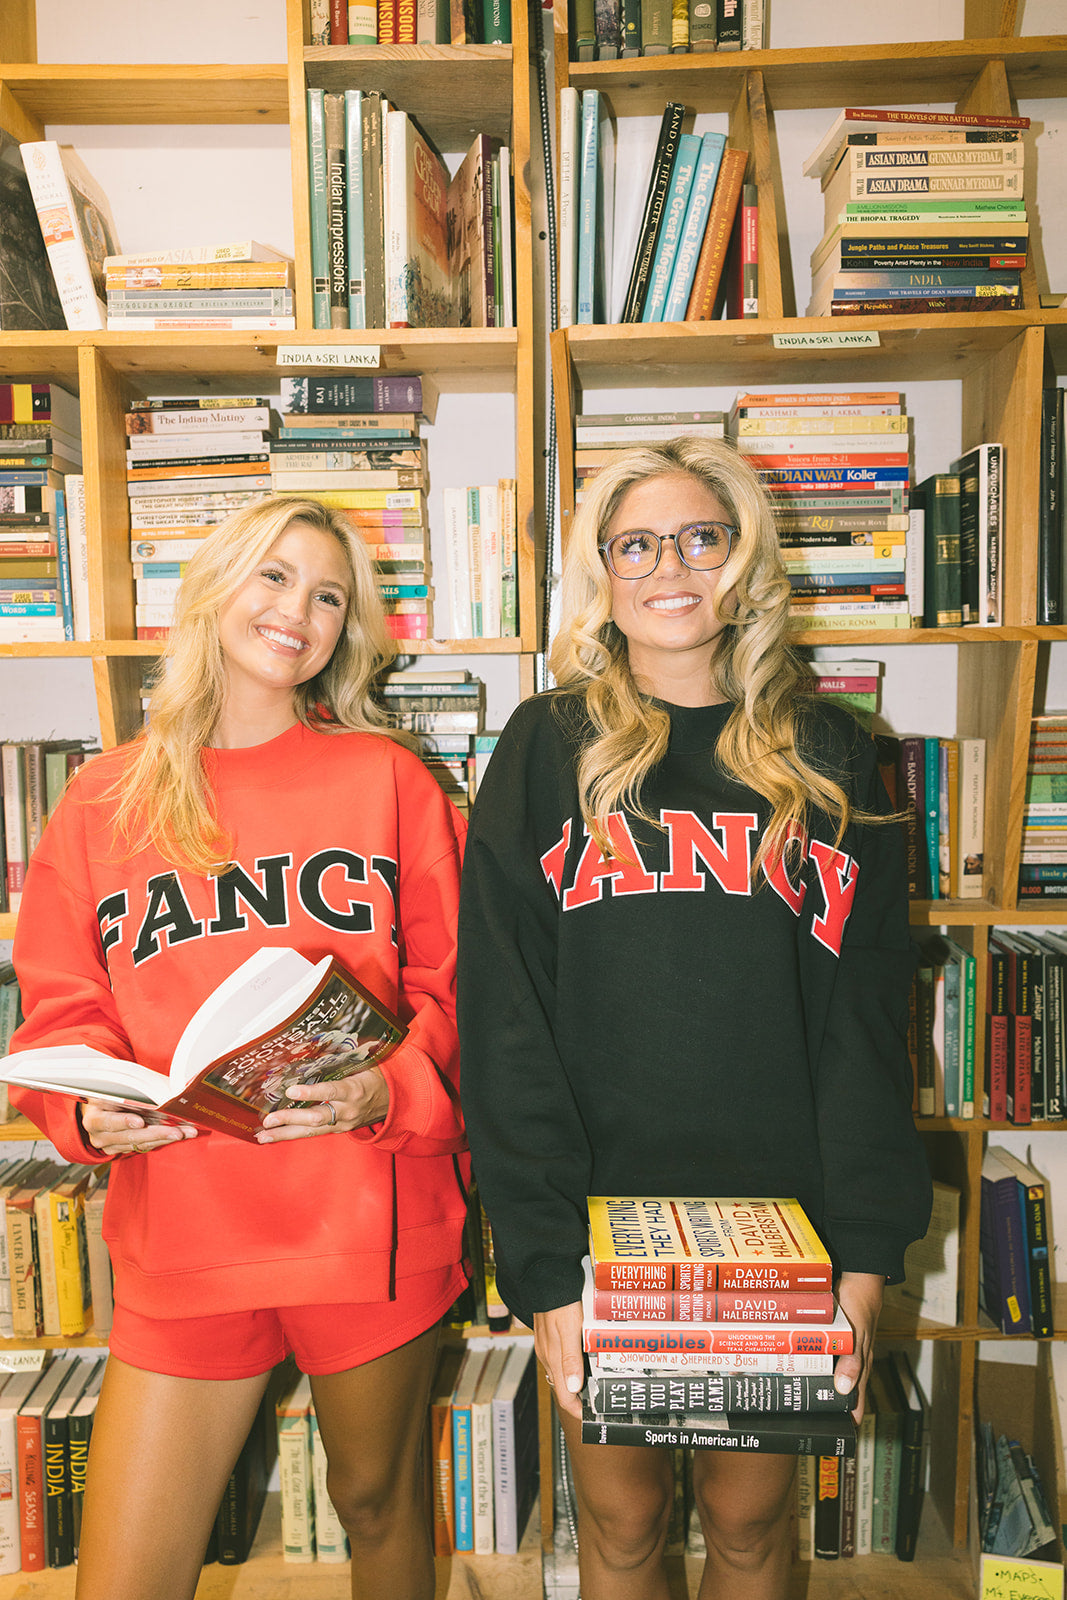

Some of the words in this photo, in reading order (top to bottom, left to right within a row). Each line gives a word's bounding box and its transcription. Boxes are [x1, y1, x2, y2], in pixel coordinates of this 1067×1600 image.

[669, 106, 682, 140] LAND
[900, 113, 925, 121] TRAVELS
[665, 143, 674, 159] OF
[868, 152, 896, 166] ASIAN
[896, 151, 928, 165] DRAMA
[929, 151, 964, 165] GUNNAR
[965, 150, 1000, 164] MYRDAL
[330, 162, 346, 206] Indian
[659, 164, 670, 186] THE
[675, 164, 692, 194] The
[869, 179, 896, 193] ASIAN
[897, 178, 929, 191] DRAMA
[930, 178, 965, 191] GUNNAR
[966, 176, 1001, 190] MYRDAL
[651, 188, 665, 224] TIGER
[666, 200, 684, 242] Great
[714, 218, 727, 258] INDIAN
[848, 244, 867, 252] Jungle
[330, 209, 348, 293] impressions
[652, 244, 675, 308] Moghuls
[701, 265, 717, 311] SUMMER
[909, 274, 942, 286] INDIA
[779, 337, 808, 345] INDIA
[282, 354, 312, 363] INDIA
[344, 355, 378, 364] LANKA
[316, 387, 325, 404] RAJ
[158, 414, 176, 425] The
[178, 414, 208, 424] Indian
[211, 412, 245, 423] Mutiny
[815, 470, 844, 481] WAY
[847, 469, 877, 480] Koller
[990, 456, 998, 526] UNTOUCHABLES
[804, 575, 835, 585] INDIA
[849, 619, 877, 627] ROOM
[819, 680, 846, 690] WALLS
[907, 762, 917, 799] BANDIT
[30, 794, 38, 822] INDIAN
[908, 845, 917, 873] INDIA
[222, 992, 343, 1082] FOOTBALL
[229, 1049, 284, 1086] STORIES
[286, 1026, 320, 1051] EVER
[322, 994, 348, 1025] TOLD
[230, 1051, 257, 1067] THE
[261, 999, 325, 1050] GREATEST
[994, 1021, 1005, 1090] BARBARIANS
[1018, 1021, 1029, 1091] BARBARIANS
[642, 1201, 666, 1223] HAD
[606, 1200, 648, 1257] EVERYTHING
[733, 1211, 765, 1246] DAVID
[749, 1201, 792, 1258] HALBERSTAM
[1034, 1222, 1042, 1241] TIBET
[13, 1223, 23, 1259] LANCER
[648, 1226, 675, 1257] THEY
[16, 1263, 24, 1274] AT
[611, 1266, 666, 1280] EVERYTHING
[680, 1264, 691, 1290] SPORTS
[693, 1264, 704, 1292] WRITING
[736, 1269, 778, 1279] DAVID
[611, 1281, 640, 1290] THEY
[643, 1281, 666, 1290] HAD
[723, 1280, 789, 1288] HALBERSTAM
[611, 1296, 666, 1310] EVERYTHING
[611, 1311, 640, 1319] THEY
[643, 1311, 666, 1319] HAD
[680, 1294, 690, 1320] SPORTS
[693, 1294, 703, 1322] WRITING
[735, 1300, 777, 1310] DAVID
[722, 1311, 789, 1320] HALBERSTAM
[596, 1333, 705, 1351] intangibles
[13, 1356, 41, 1366] LANKA
[610, 1384, 626, 1408] IT'S
[631, 1381, 646, 1410] HOW
[650, 1384, 665, 1408] YOU
[670, 1380, 684, 1410] PLAY
[689, 1383, 704, 1408] THE
[709, 1378, 723, 1411] GAME
[784, 1384, 792, 1406] BRIAN
[26, 1438, 34, 1450] THE
[457, 1416, 467, 1452] PLANET
[599, 1425, 607, 1444] Davies
[645, 1430, 677, 1445] Sports
[680, 1432, 688, 1444] in
[691, 1433, 738, 1447] American
[741, 1435, 759, 1448] Life
[70, 1440, 87, 1493] INDIA
[478, 1439, 488, 1472] Women
[25, 1454, 37, 1486] KILLING
[46, 1444, 64, 1496] INDIA
[458, 1455, 467, 1481] INDIA
[479, 1475, 488, 1485] of
[436, 1458, 450, 1522] Maharanis
[479, 1486, 488, 1500] the
[25, 1491, 36, 1528] SEASON
[478, 1502, 488, 1516] Raj
[1000, 1570, 1037, 1584] MAPS
